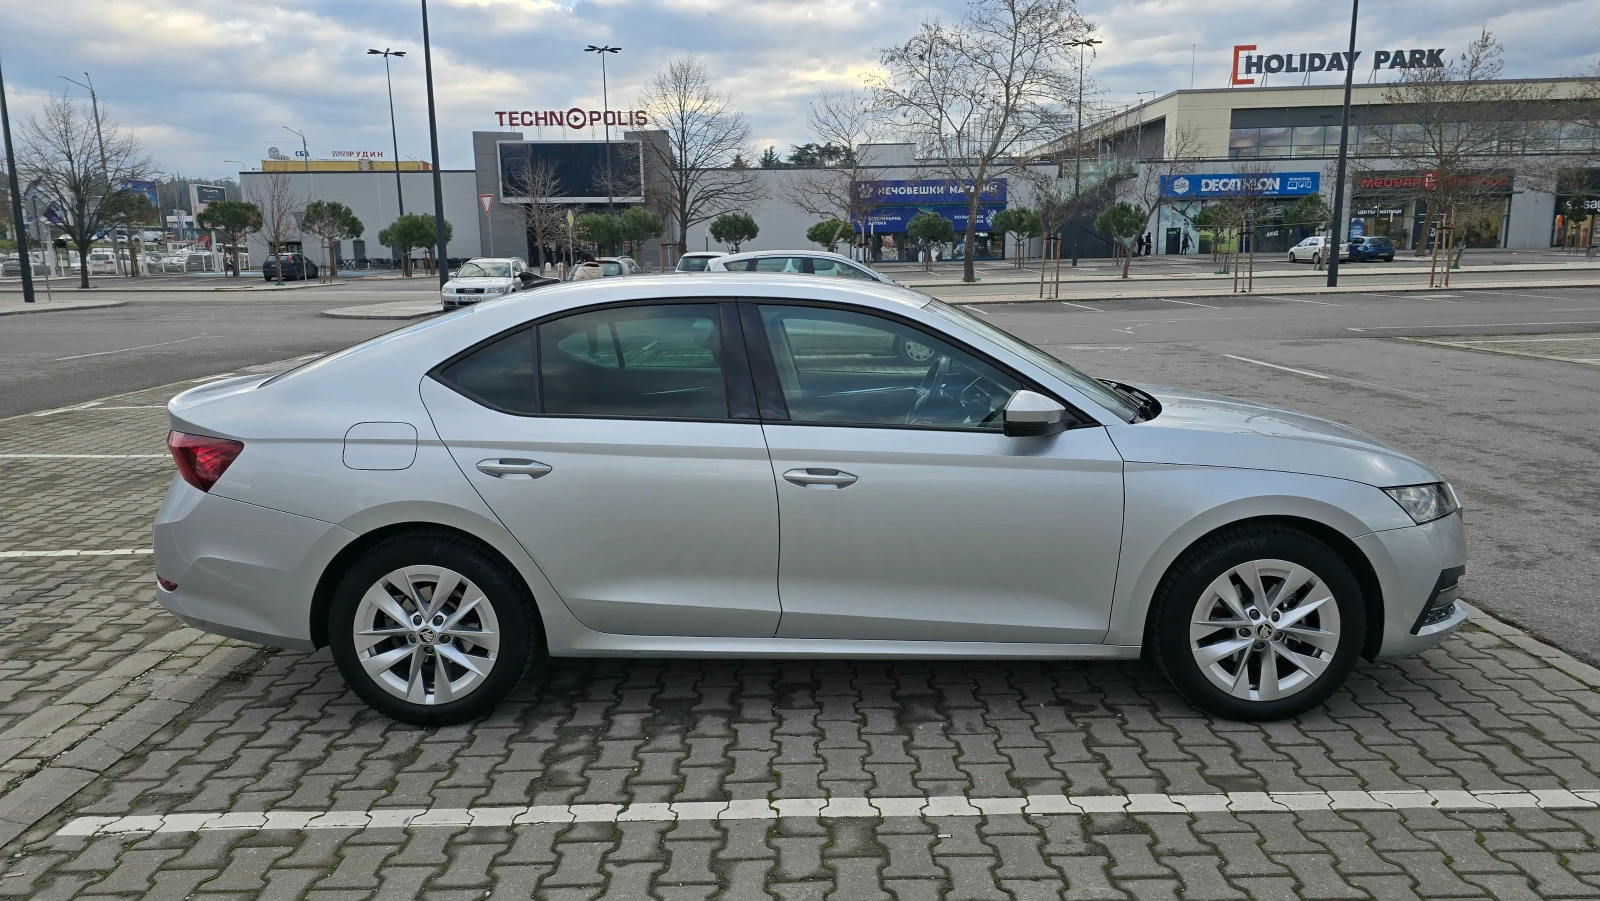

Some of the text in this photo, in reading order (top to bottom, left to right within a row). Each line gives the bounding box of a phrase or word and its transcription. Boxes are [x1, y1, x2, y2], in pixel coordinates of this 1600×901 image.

[1245, 48, 1446, 74] HOLIDAY PARK
[495, 108, 648, 129] TECHNOPOLIS
[877, 184, 998, 196] НЕЧОВЕШКИ МАГАИН
